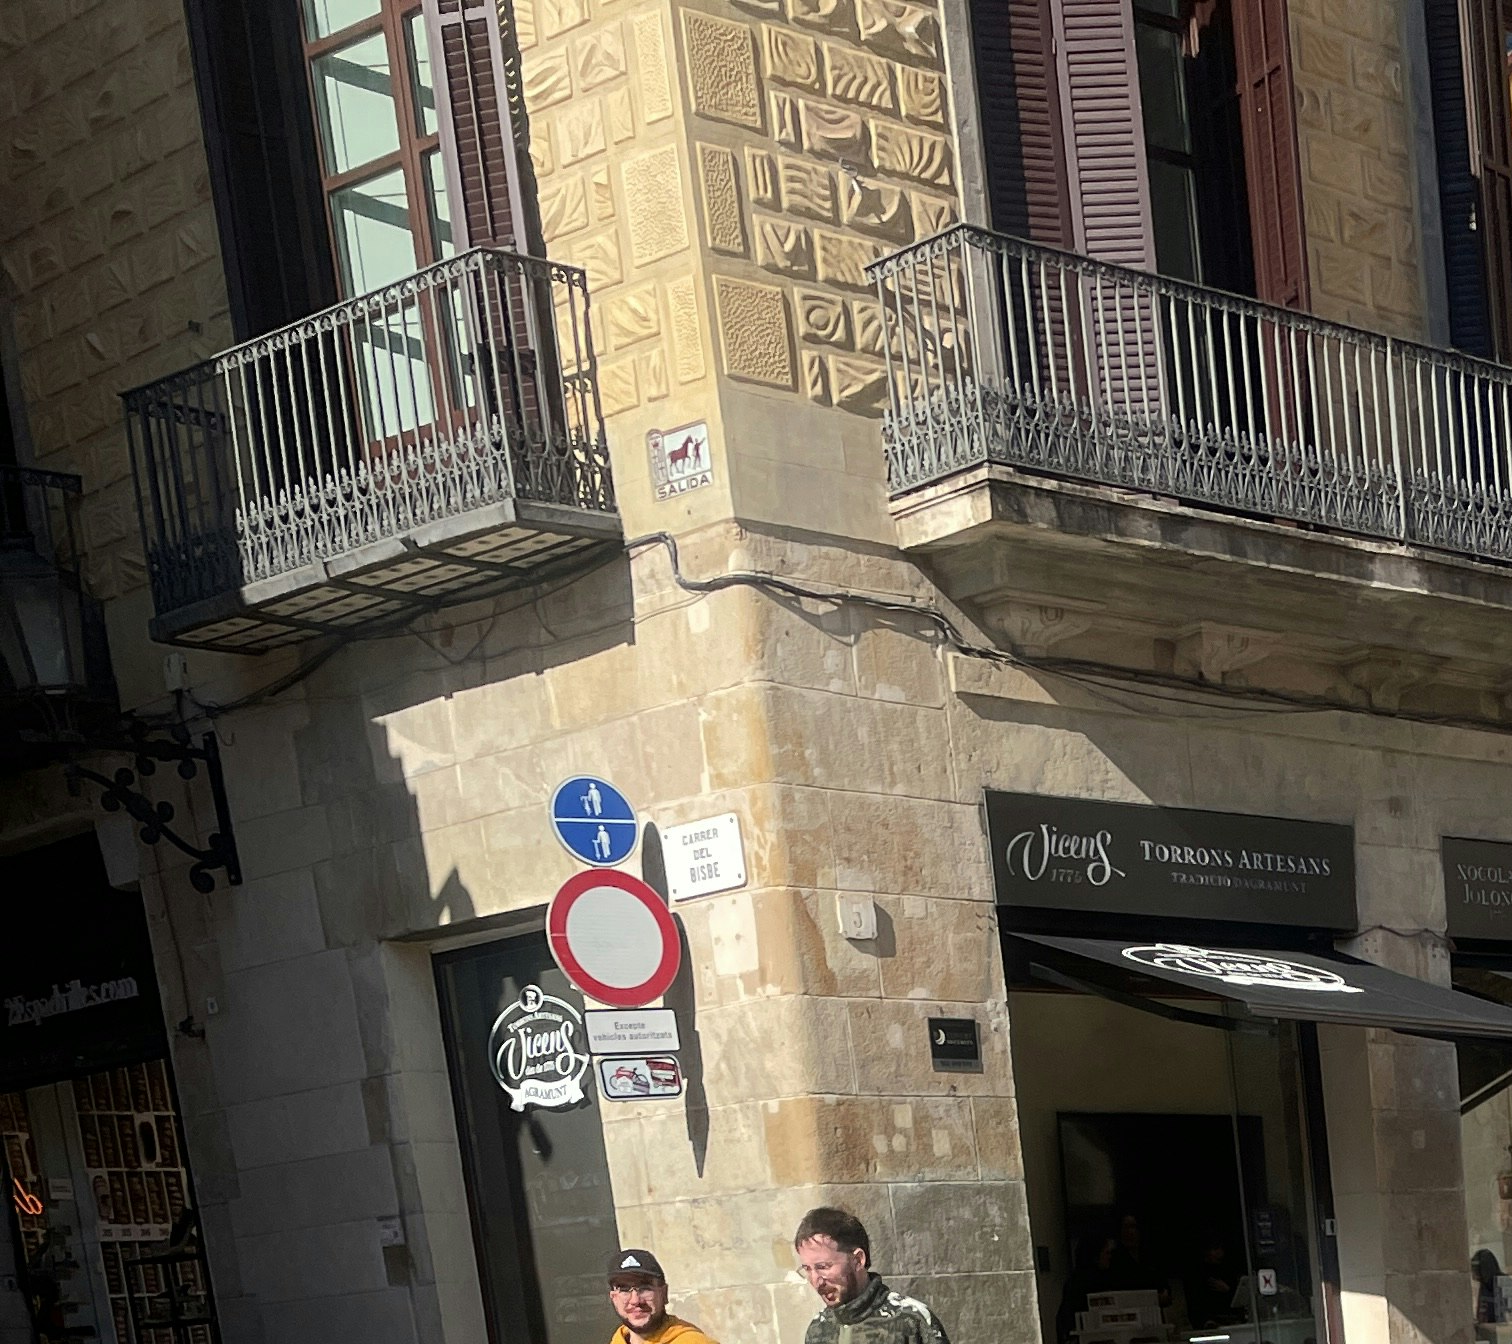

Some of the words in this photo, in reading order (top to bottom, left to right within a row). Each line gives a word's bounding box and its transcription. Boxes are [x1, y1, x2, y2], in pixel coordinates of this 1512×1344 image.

[658, 474, 710, 499] SALIDA
[682, 828, 719, 845] CARRER
[693, 847, 712, 860] DEL
[1006, 823, 1126, 886] Vicens
[1140, 840, 1233, 867] TORRONS
[1238, 850, 1331, 876] ARTESANS
[690, 861, 720, 883] BISBE
[593, 1032, 627, 1041] vehicles
[497, 1020, 588, 1080] Vicens
[525, 1084, 568, 1100] AGRAMUNT
